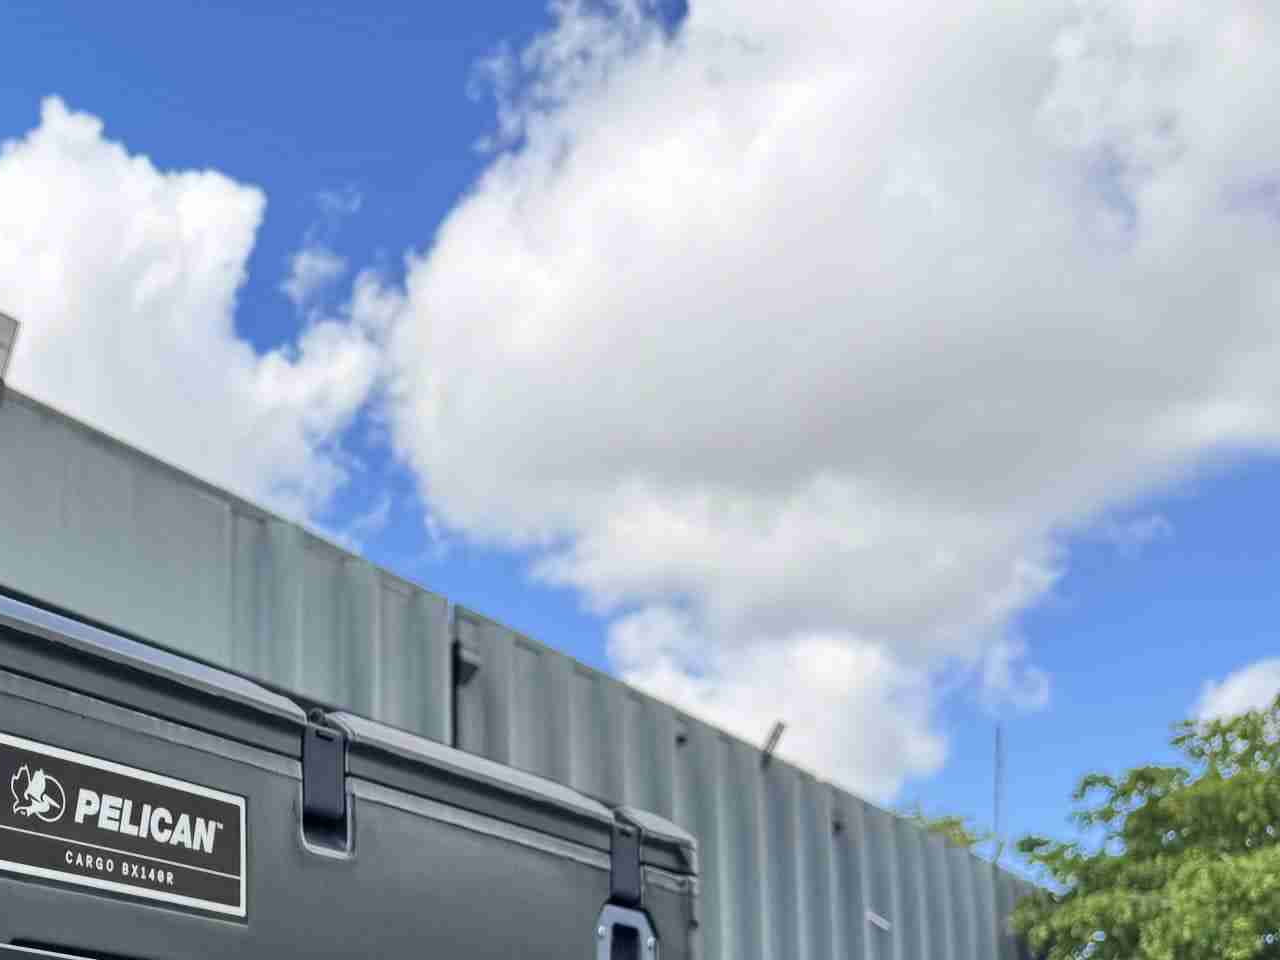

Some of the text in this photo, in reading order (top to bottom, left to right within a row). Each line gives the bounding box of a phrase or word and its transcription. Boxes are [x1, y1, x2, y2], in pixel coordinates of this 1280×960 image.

[74, 787, 216, 854] PELICAN
[65, 850, 174, 886] CARGO BX140R
